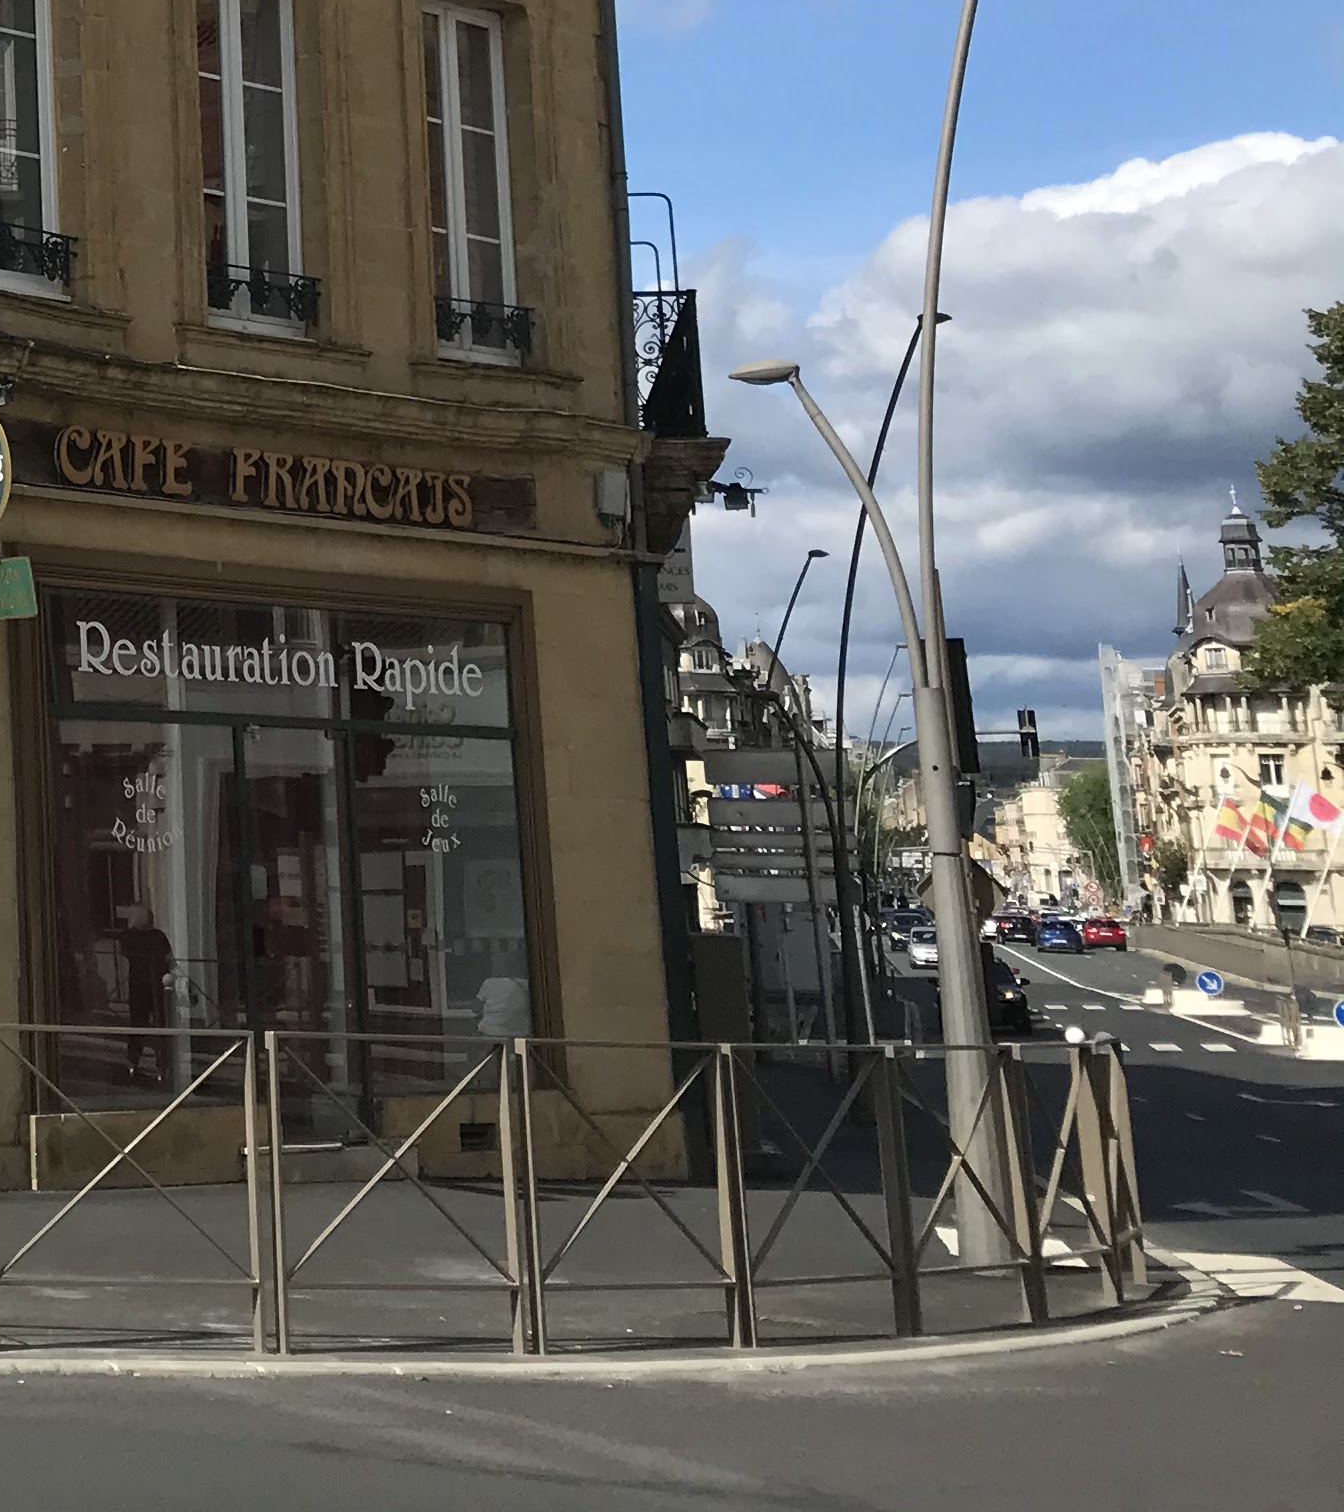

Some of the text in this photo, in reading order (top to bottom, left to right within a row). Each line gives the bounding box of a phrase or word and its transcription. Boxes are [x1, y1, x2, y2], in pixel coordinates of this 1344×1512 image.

[58, 424, 193, 496] CAFE
[76, 620, 484, 711] Restauration Rapide
[123, 772, 166, 799] Salle
[420, 784, 458, 808] Salle
[136, 802, 156, 824] de
[432, 808, 449, 828] de
[111, 816, 183, 853] Réunion
[422, 829, 461, 853] Jeux
